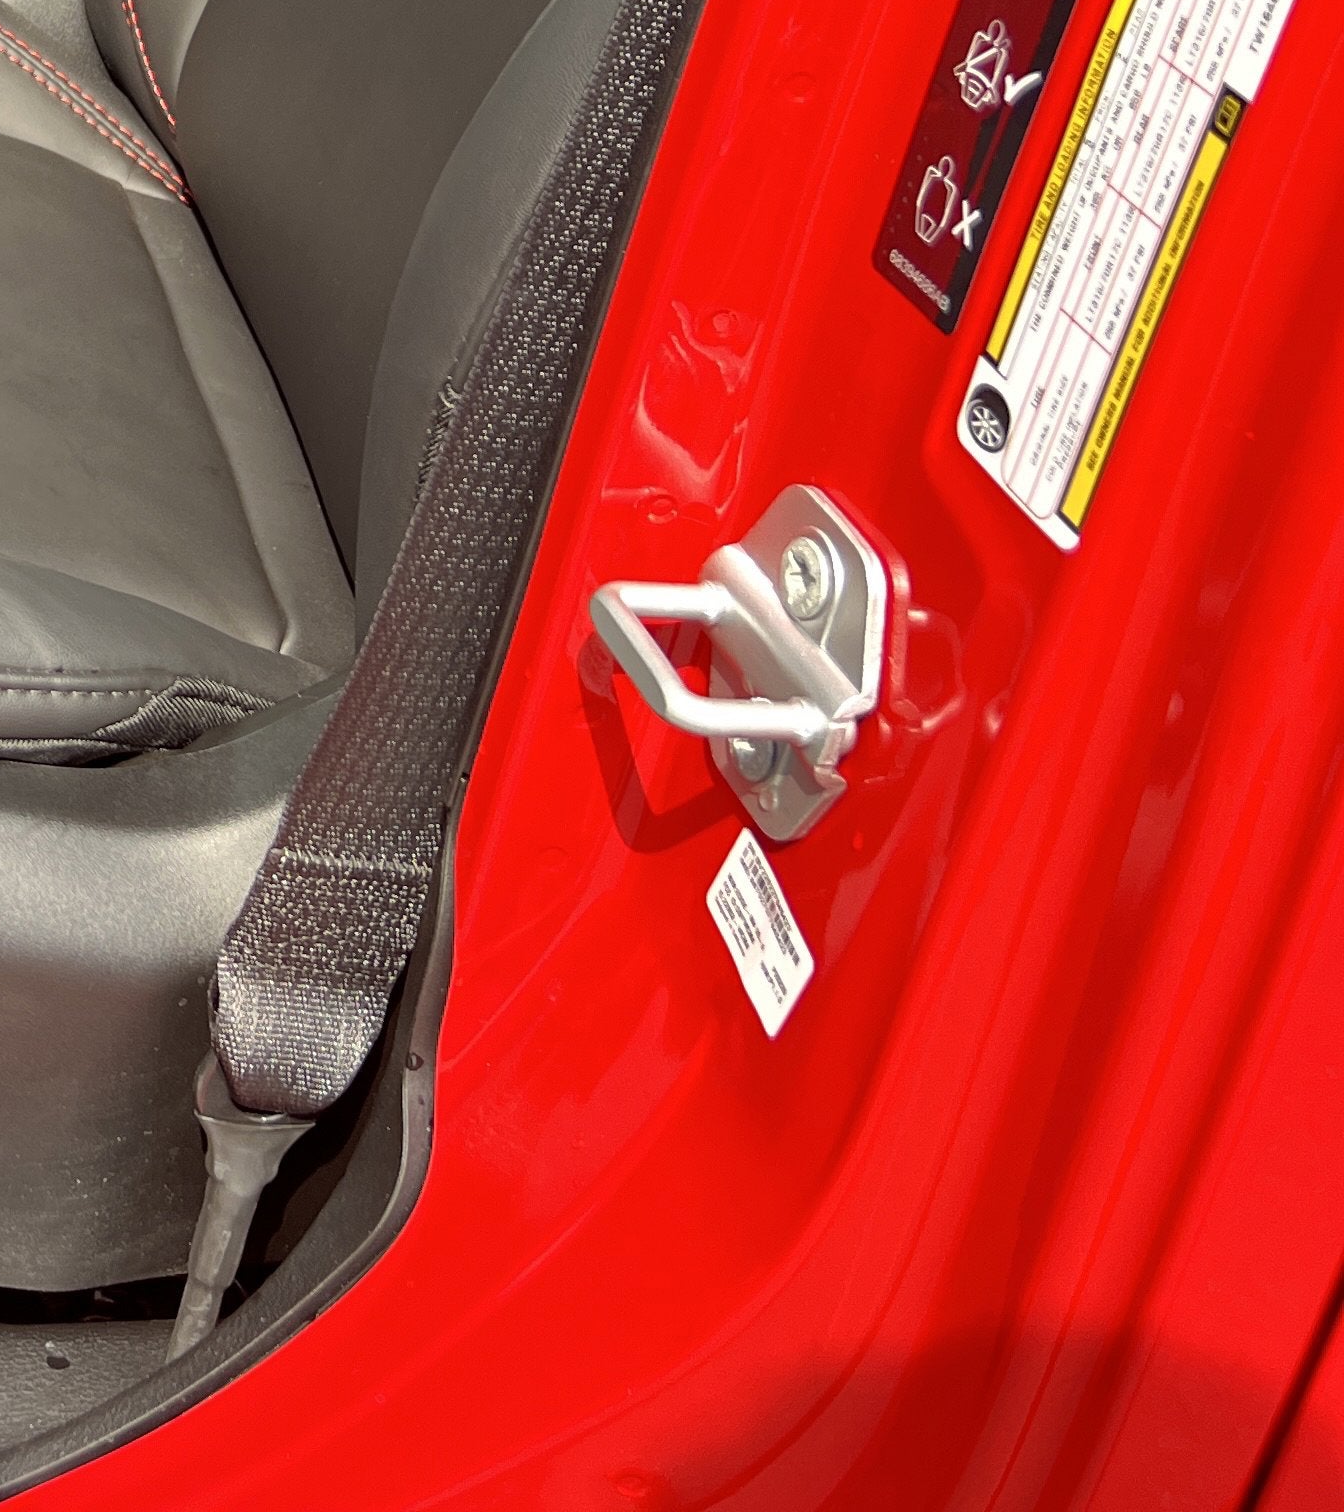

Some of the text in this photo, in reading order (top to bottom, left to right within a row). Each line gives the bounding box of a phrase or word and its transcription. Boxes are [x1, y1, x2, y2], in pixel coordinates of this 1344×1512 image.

[1029, 26, 1117, 243] TIRE AND LOADING INFORMATION
